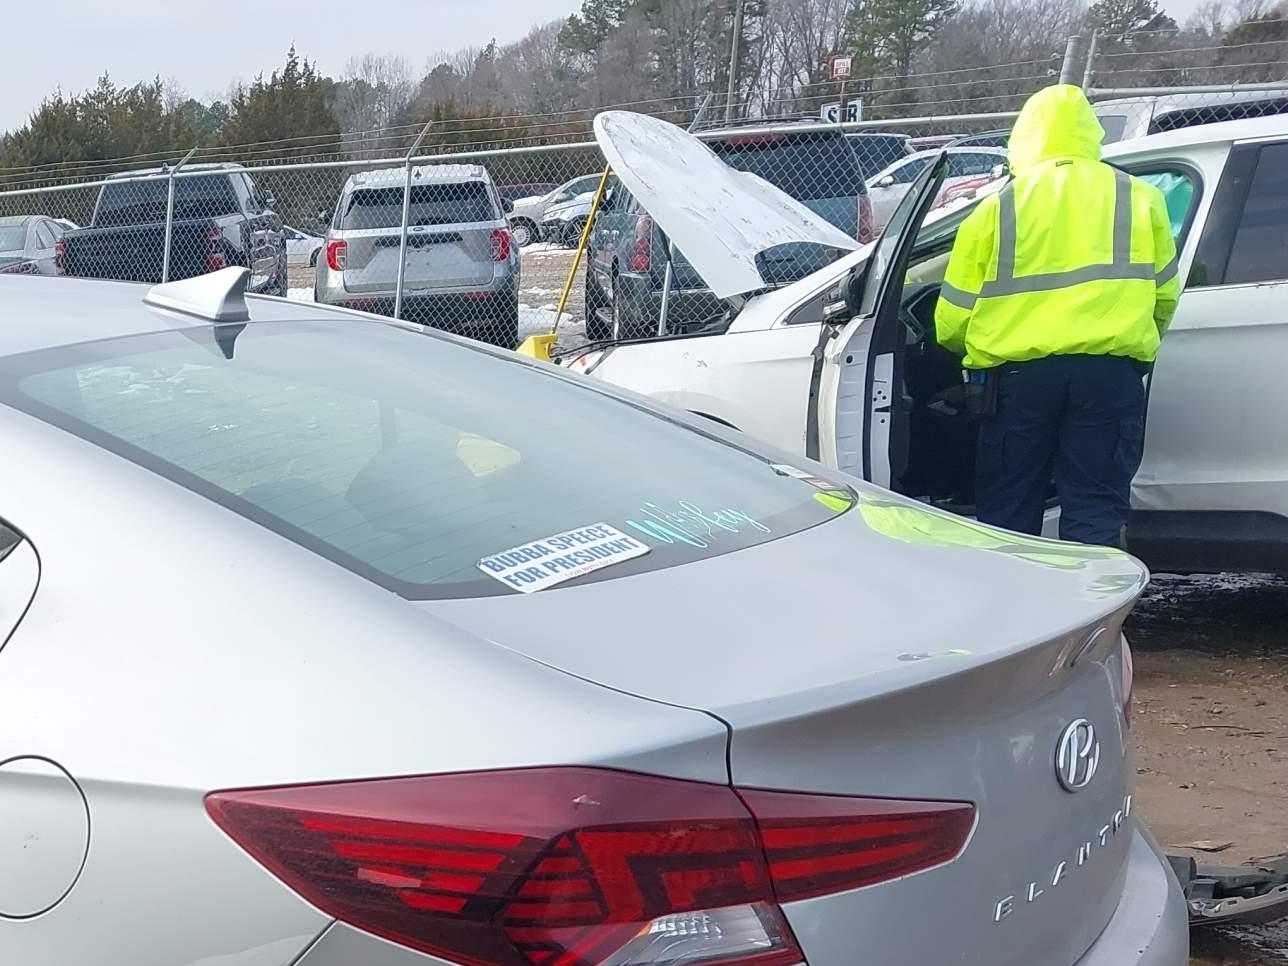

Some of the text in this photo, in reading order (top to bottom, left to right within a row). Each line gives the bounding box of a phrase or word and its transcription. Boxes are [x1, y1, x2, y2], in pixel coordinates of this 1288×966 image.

[482, 543, 555, 572] BUBBA
[547, 525, 617, 550] SPEECE
[503, 566, 549, 587] FOR
[542, 538, 640, 573] PRESIDENT
